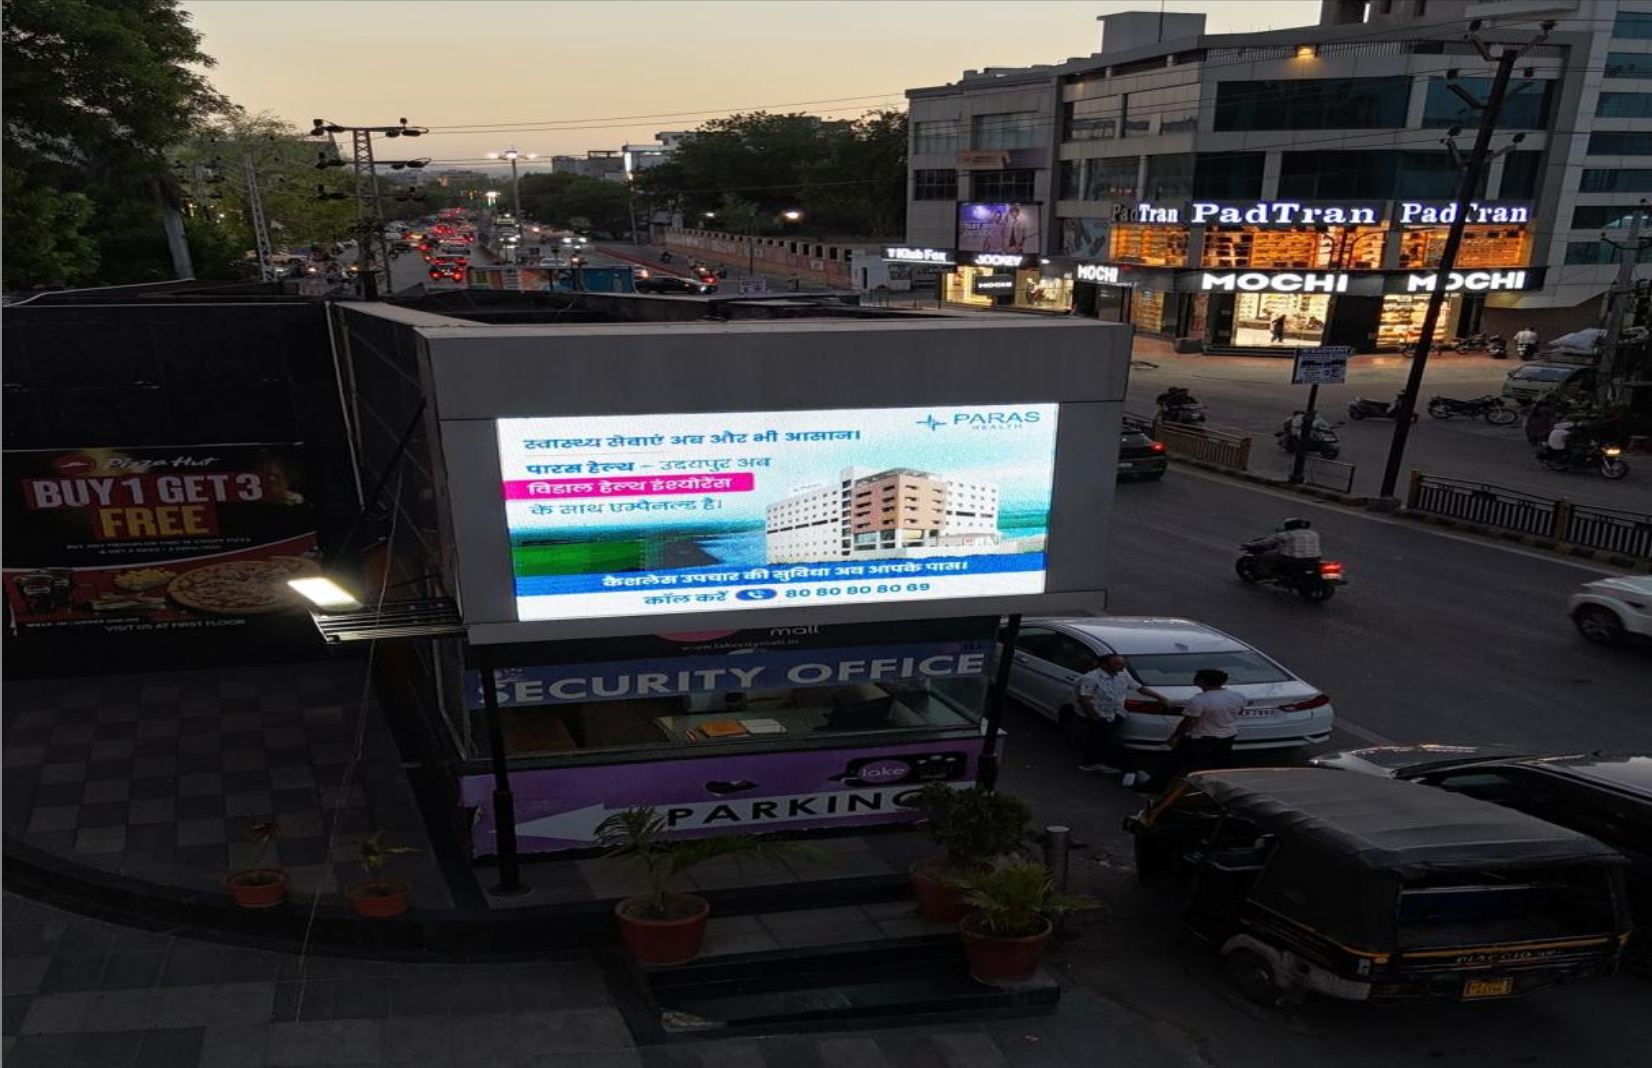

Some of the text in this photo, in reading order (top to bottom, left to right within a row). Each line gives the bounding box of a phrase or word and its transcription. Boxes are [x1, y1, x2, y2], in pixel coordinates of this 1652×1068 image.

[1112, 202, 1180, 223] PadTran
[1191, 201, 1377, 225] PadTran
[974, 253, 1024, 267] JOCKEY
[1077, 264, 1119, 283] MOCHI
[1201, 272, 1348, 294] MOCHI
[952, 411, 1041, 426] PARAS
[524, 429, 861, 450] स्वास्थ्य सेवाएं अब और भी आसान।
[526, 462, 583, 476] पारस
[587, 459, 634, 475] हेल्थ
[659, 457, 731, 472] उदयपुर
[736, 456, 771, 469] अब
[33, 473, 264, 508] BUY 1 GET 3
[526, 475, 733, 495] विडाल हेल्थ इंश्योरेंस
[530, 501, 553, 516] के
[559, 501, 603, 515] साथ
[97, 504, 212, 538] FREE
[602, 573, 678, 588] कैशलेस
[681, 572, 739, 585] उपचार
[743, 568, 770, 582] की
[772, 565, 830, 583] सुविधा
[834, 565, 863, 577] अब
[868, 561, 921, 575] आपके
[644, 589, 730, 606] कॉल करें
[785, 588, 811, 598] 80
[815, 586, 841, 597] 80
[846, 585, 872, 595] 80
[876, 584, 901, 594] 80
[105, 624, 134, 633] VISIT
[769, 624, 820, 637] mall
[477, 653, 985, 707] SECURITY OFFICE
[861, 765, 907, 779] lake
